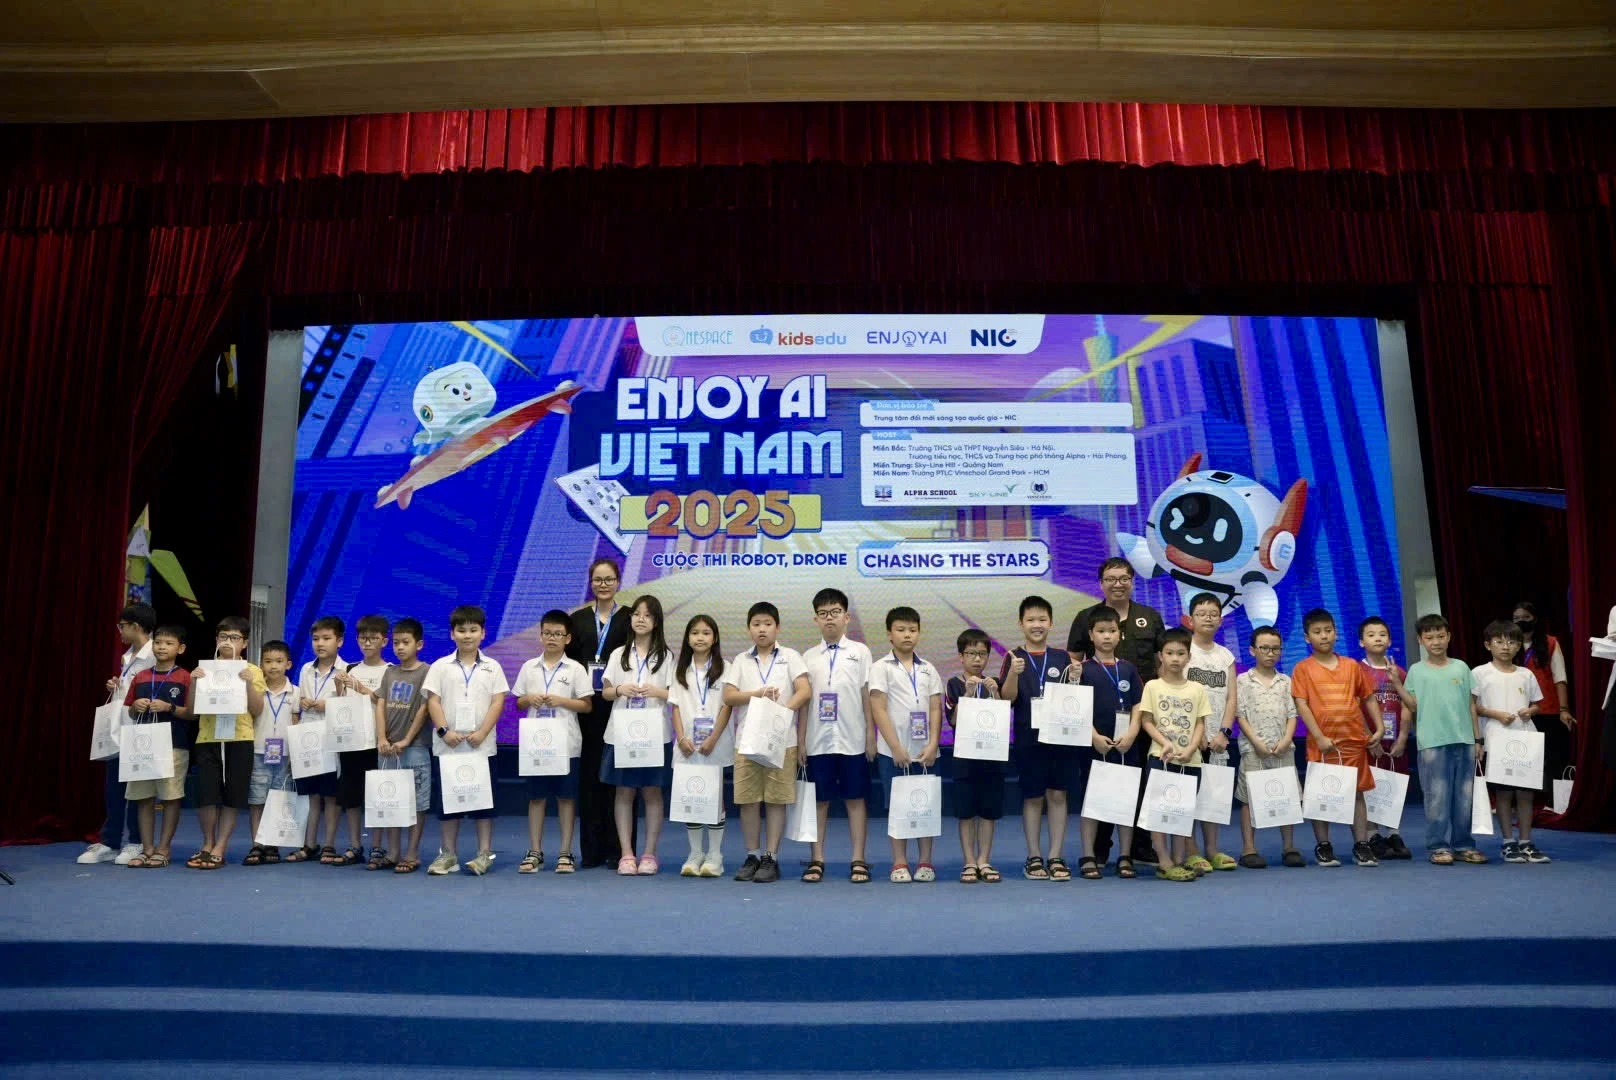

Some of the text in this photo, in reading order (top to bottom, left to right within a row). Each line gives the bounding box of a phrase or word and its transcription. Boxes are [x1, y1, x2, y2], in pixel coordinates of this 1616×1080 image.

[778, 330, 847, 346] kidsedu
[970, 328, 1017, 347] NIC
[616, 375, 827, 421] ENJOY AI
[873, 415, 893, 423] Trung
[987, 414, 998, 423] gia
[599, 427, 843, 483] VIỆT NAM
[995, 453, 1014, 461] Trung
[1065, 452, 1085, 461] Alpha
[891, 462, 913, 470] Trung:
[914, 462, 944, 470] Sky-Line
[644, 489, 796, 538] 2025
[652, 551, 848, 569] CUỘC THI ROBOT, DRONE
[863, 553, 1040, 569] CHASING THE STARS
